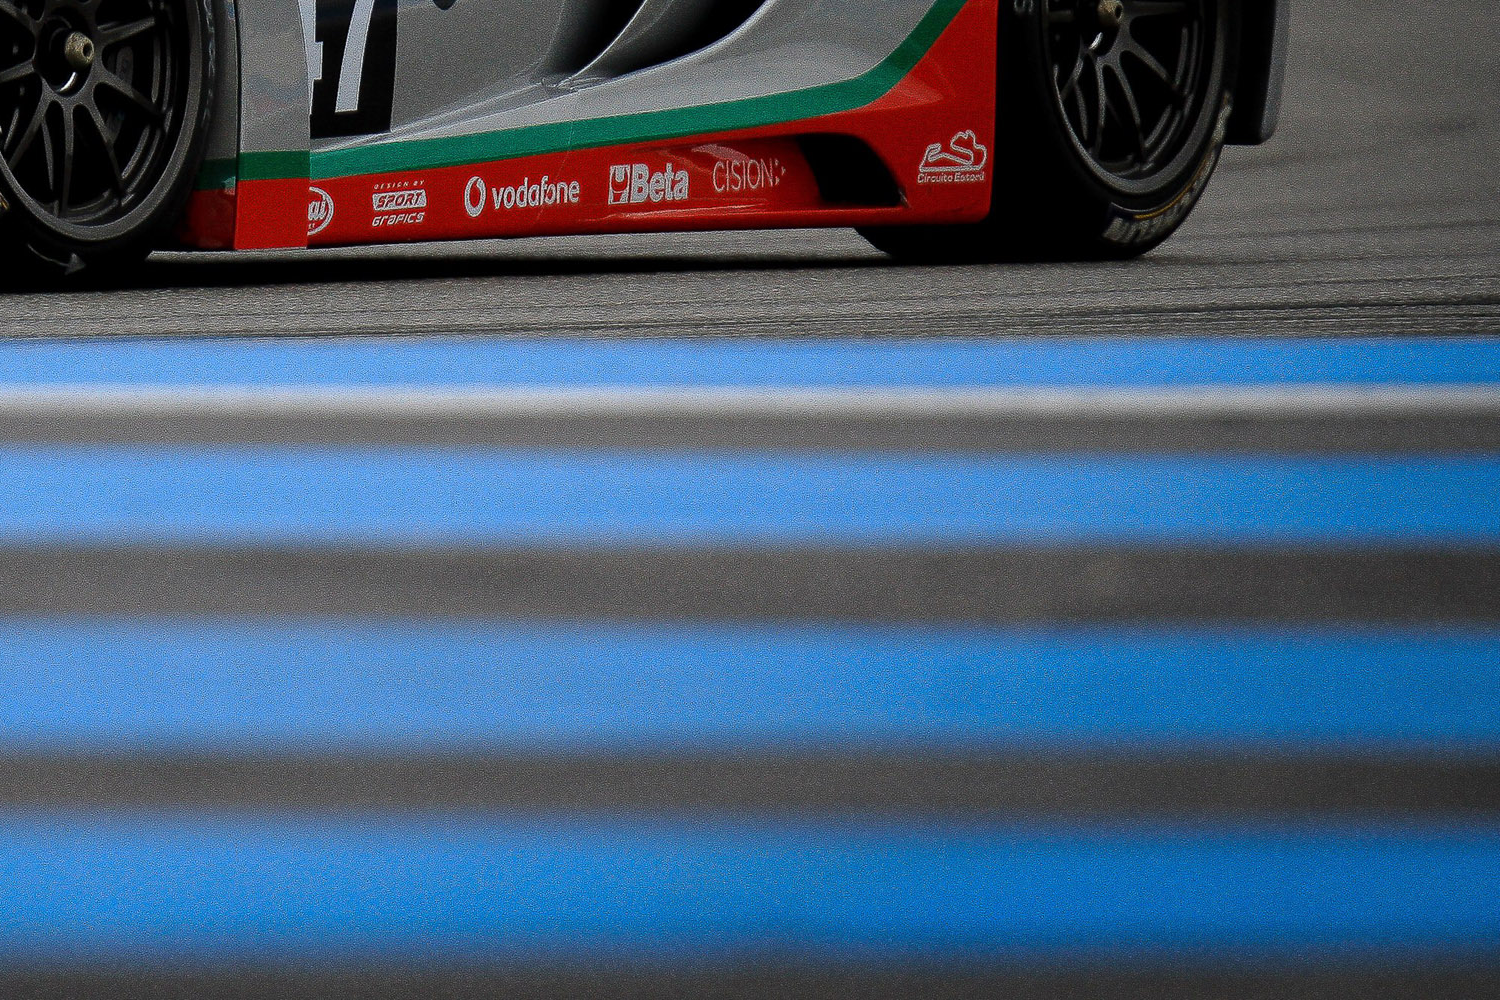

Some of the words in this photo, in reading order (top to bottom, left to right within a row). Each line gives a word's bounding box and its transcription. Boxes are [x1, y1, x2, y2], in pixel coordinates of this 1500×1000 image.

[492, 175, 581, 210] vodafone
[630, 163, 689, 203] Beta
[712, 159, 775, 193] CISION
[917, 173, 953, 184] Circuito
[376, 191, 423, 209] SPORT
